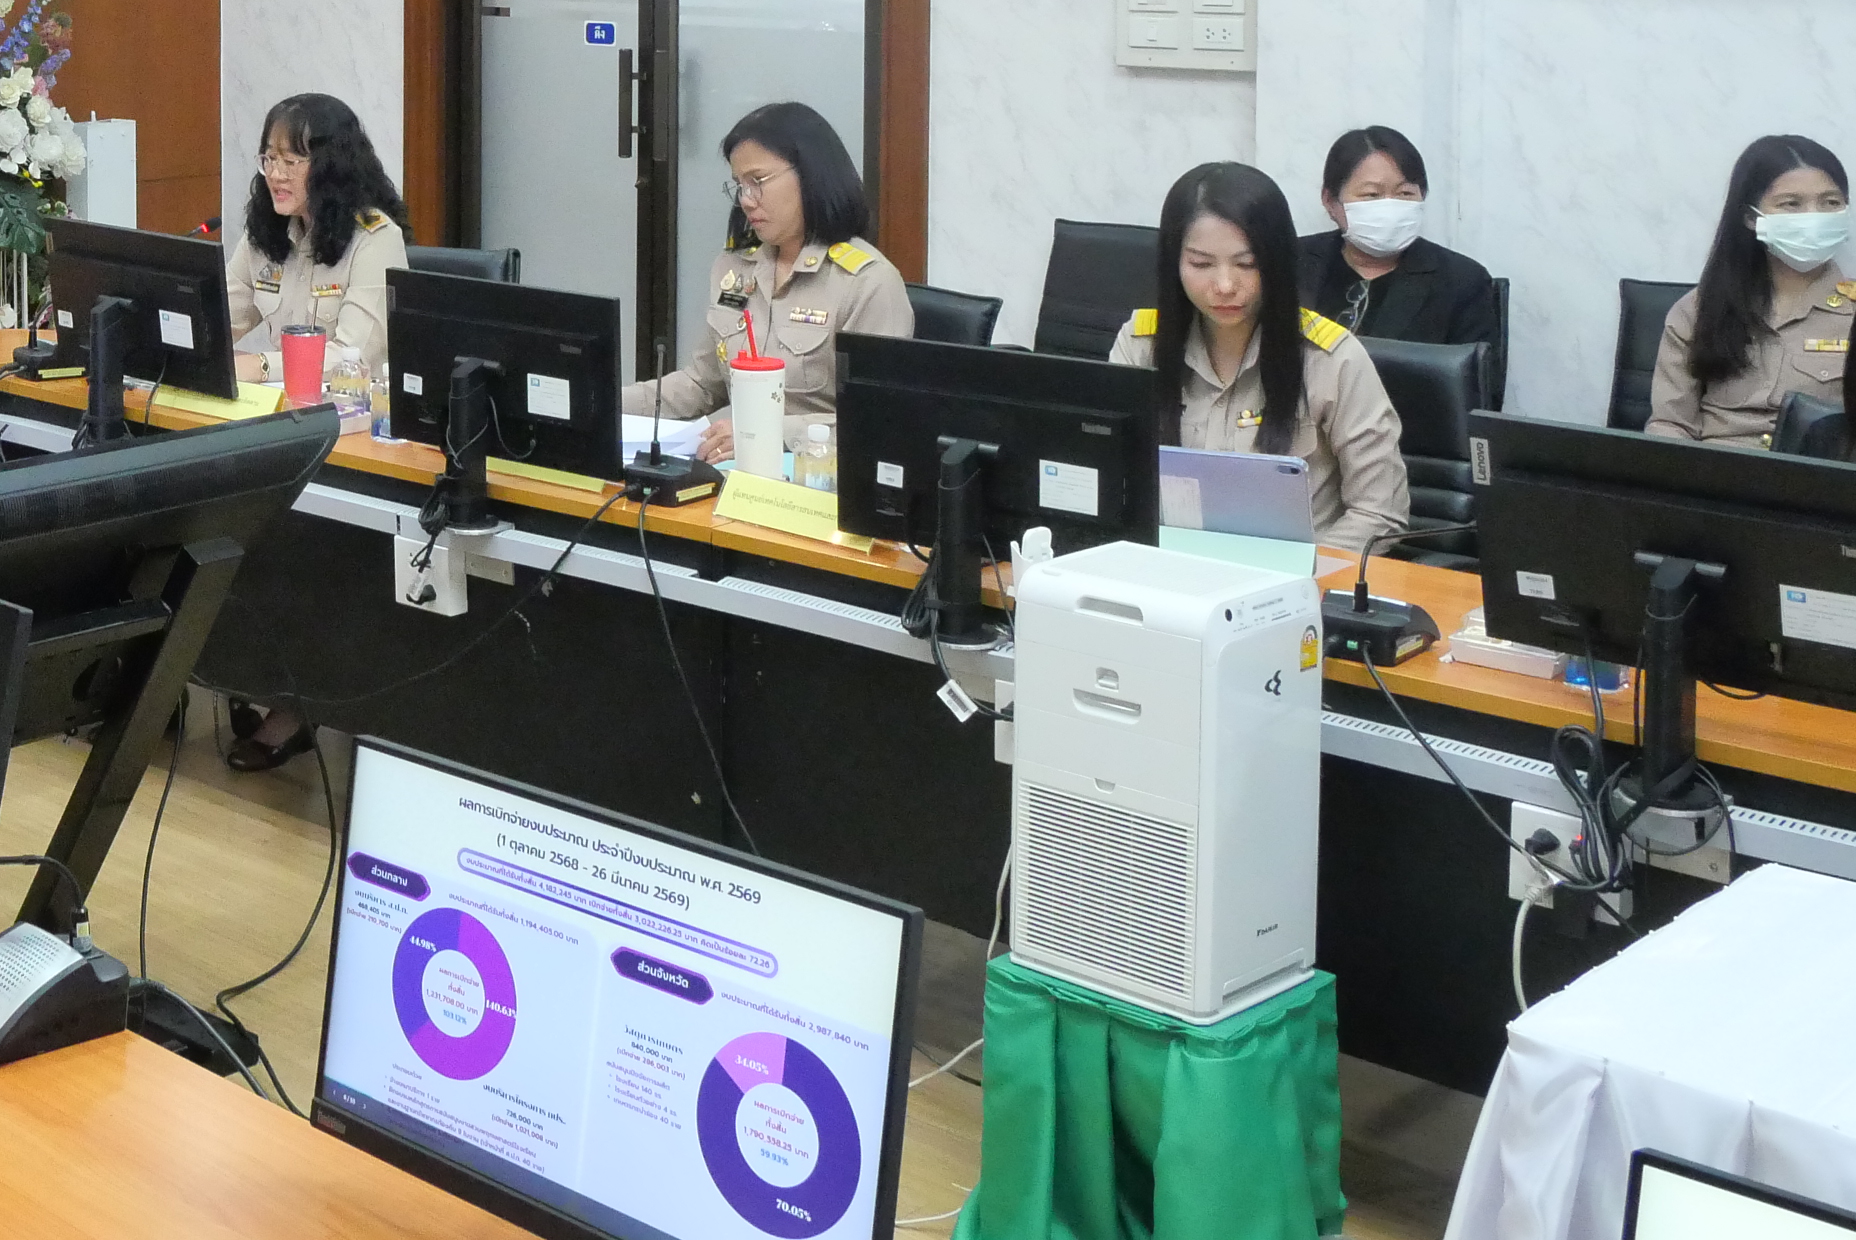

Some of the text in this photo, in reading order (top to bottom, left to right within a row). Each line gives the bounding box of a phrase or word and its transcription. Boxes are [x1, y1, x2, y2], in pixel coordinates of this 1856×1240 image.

[1477, 442, 1486, 481] Lenovo
[459, 797, 761, 904] ผลการเบิกจ่ายงบประมาณ ประจำปีงบประมาณ พ.ศ. 2569
[370, 864, 408, 888] ส่วนกลาง
[510, 839, 546, 860] ตุลาคม
[550, 851, 578, 870] 2568
[592, 865, 606, 880] 26
[610, 870, 649, 894] มีนาคม
[654, 886, 690, 911] 2569)
[574, 894, 586, 905] บาท
[684, 933, 698, 944] บาท
[410, 936, 437, 953] 44.98%
[566, 935, 578, 946] บาท
[638, 960, 689, 988] ส่วนจังหวัด
[808, 1022, 851, 1044] 2,987,840
[854, 1040, 869, 1051] บาท
[734, 1054, 769, 1076] 34.05%
[794, 1147, 809, 1160] บาท
[776, 1198, 812, 1222] 70.05%
